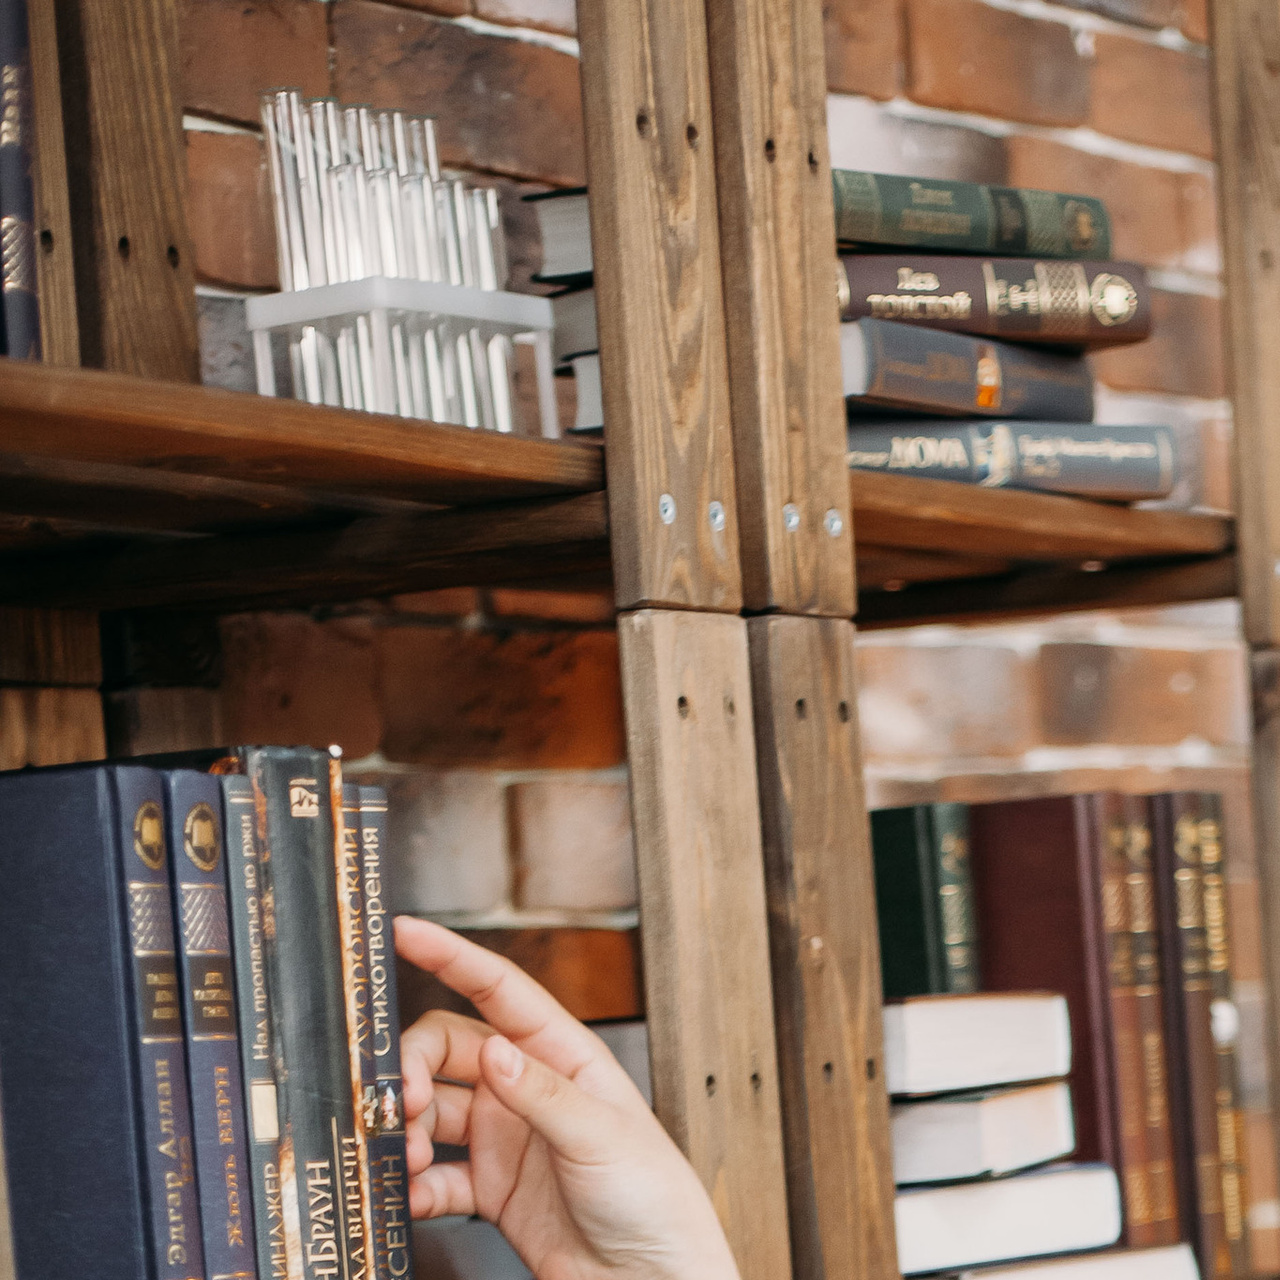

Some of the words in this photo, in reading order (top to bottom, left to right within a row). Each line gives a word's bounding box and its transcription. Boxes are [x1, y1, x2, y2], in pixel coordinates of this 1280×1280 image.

[241, 814, 257, 857] ржи
[244, 864, 257, 889] во
[247, 896, 269, 1013] пропастью
[362, 827, 392, 1057] Стихотворения
[252, 1018, 270, 1061] Над
[155, 1059, 178, 1158] Аллан
[214, 1066, 234, 1145] ВЕРН
[166, 1171, 187, 1266] Эдгар
[224, 1155, 244, 1246] Жюль
[342, 1137, 366, 1239] ВИНЧИ
